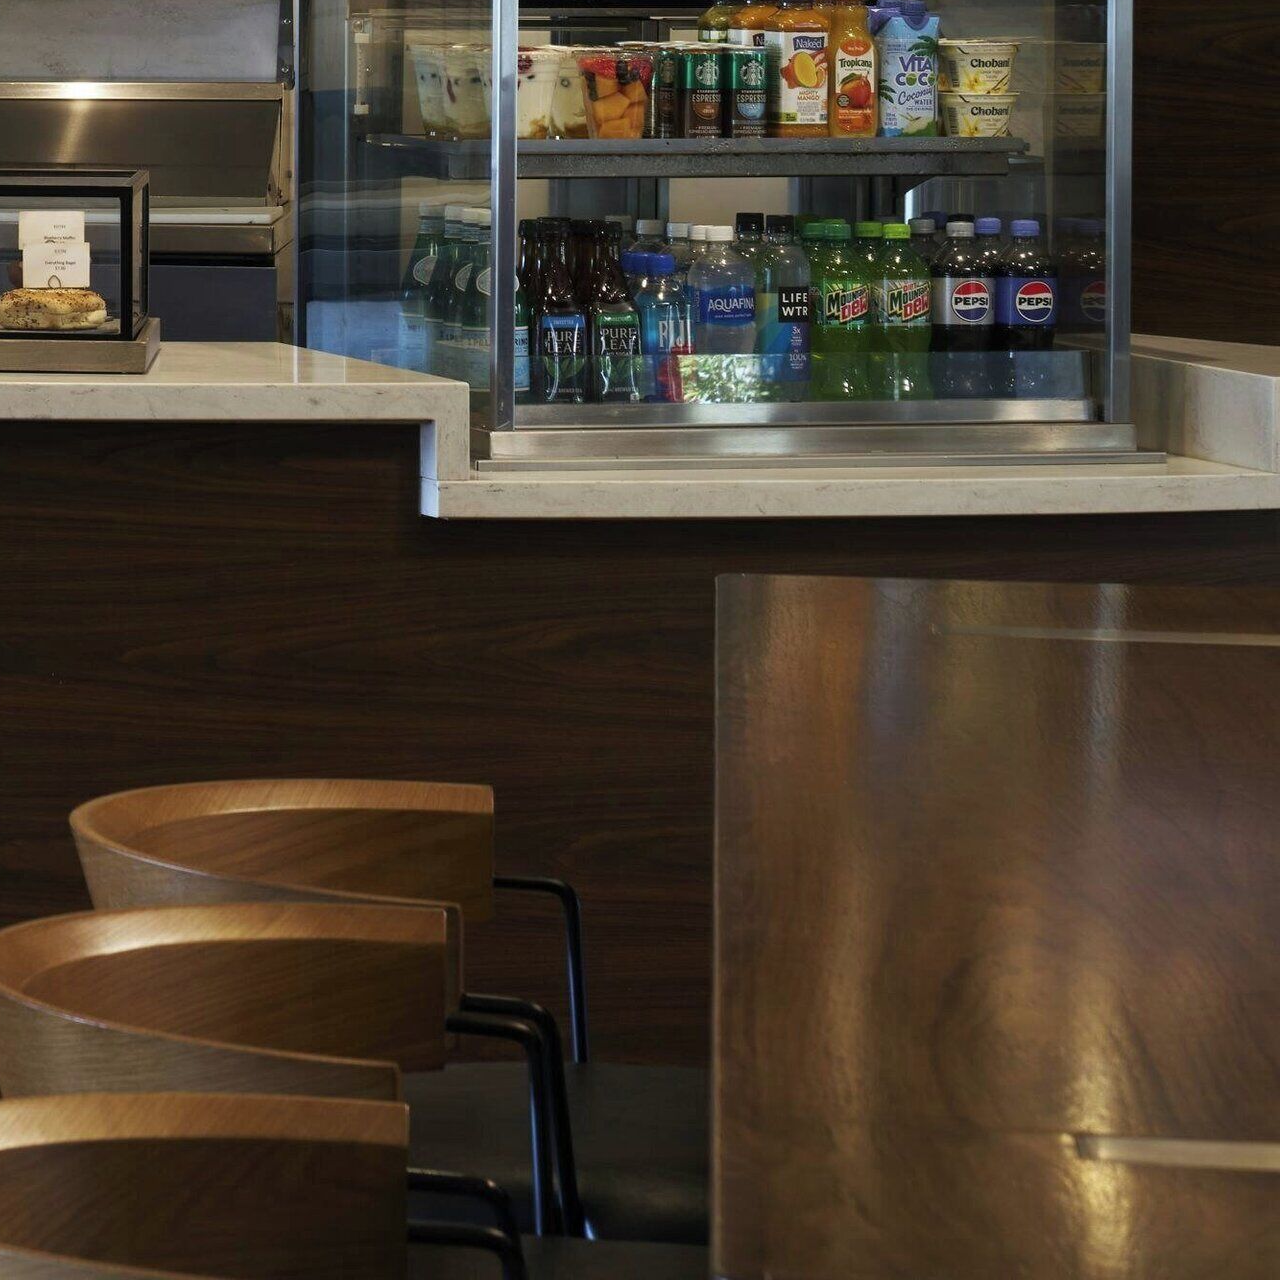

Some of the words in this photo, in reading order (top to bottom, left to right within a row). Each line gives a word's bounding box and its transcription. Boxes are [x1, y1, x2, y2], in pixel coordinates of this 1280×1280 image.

[796, 38, 822, 49] Naked
[839, 59, 872, 69] Tropicana
[899, 54, 934, 72] VITA
[970, 58, 1010, 68] Chobani
[782, 293, 808, 302] LIFE
[954, 297, 988, 306] PEPSI
[1018, 297, 1052, 306] PEPSI
[782, 307, 808, 316] WTR
[602, 328, 636, 338] PURE
